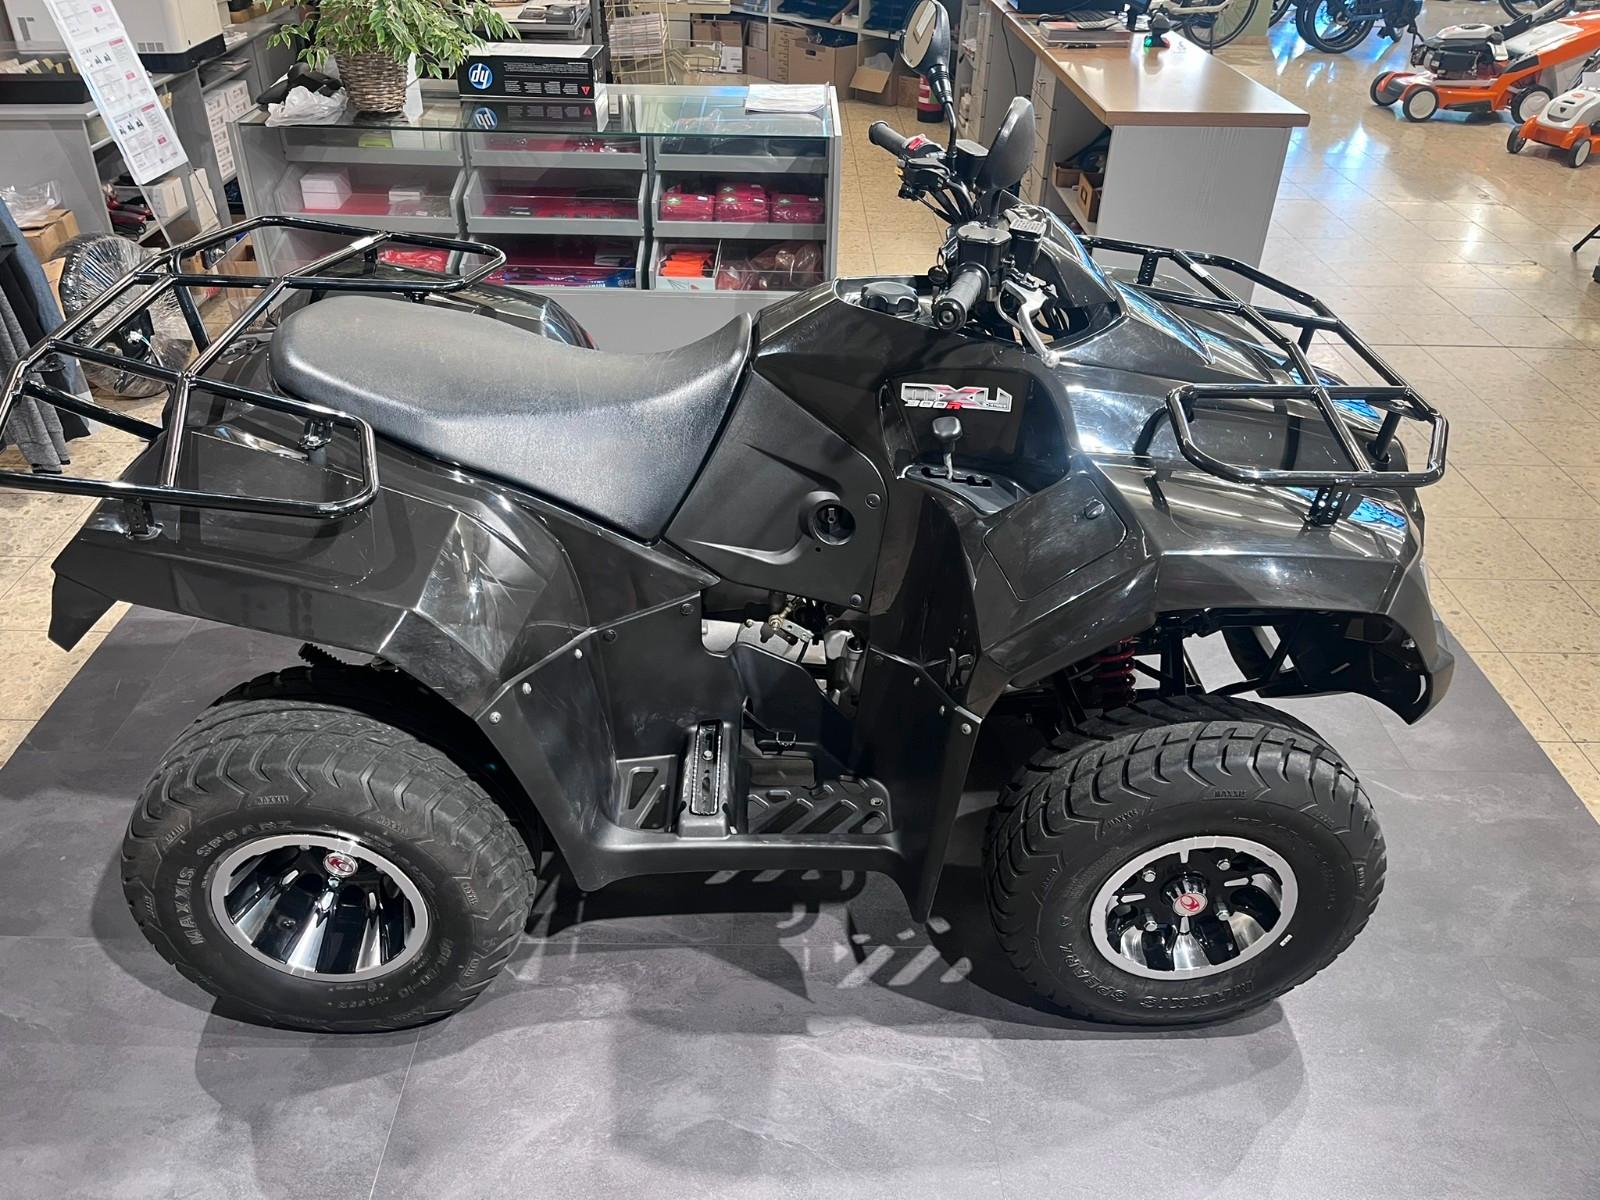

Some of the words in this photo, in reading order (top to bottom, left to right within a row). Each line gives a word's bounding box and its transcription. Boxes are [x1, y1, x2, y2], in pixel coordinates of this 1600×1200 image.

[469, 63, 490, 90] hp
[174, 866, 205, 946] MAXXIS
[1139, 981, 1254, 1009] MAXXIS
